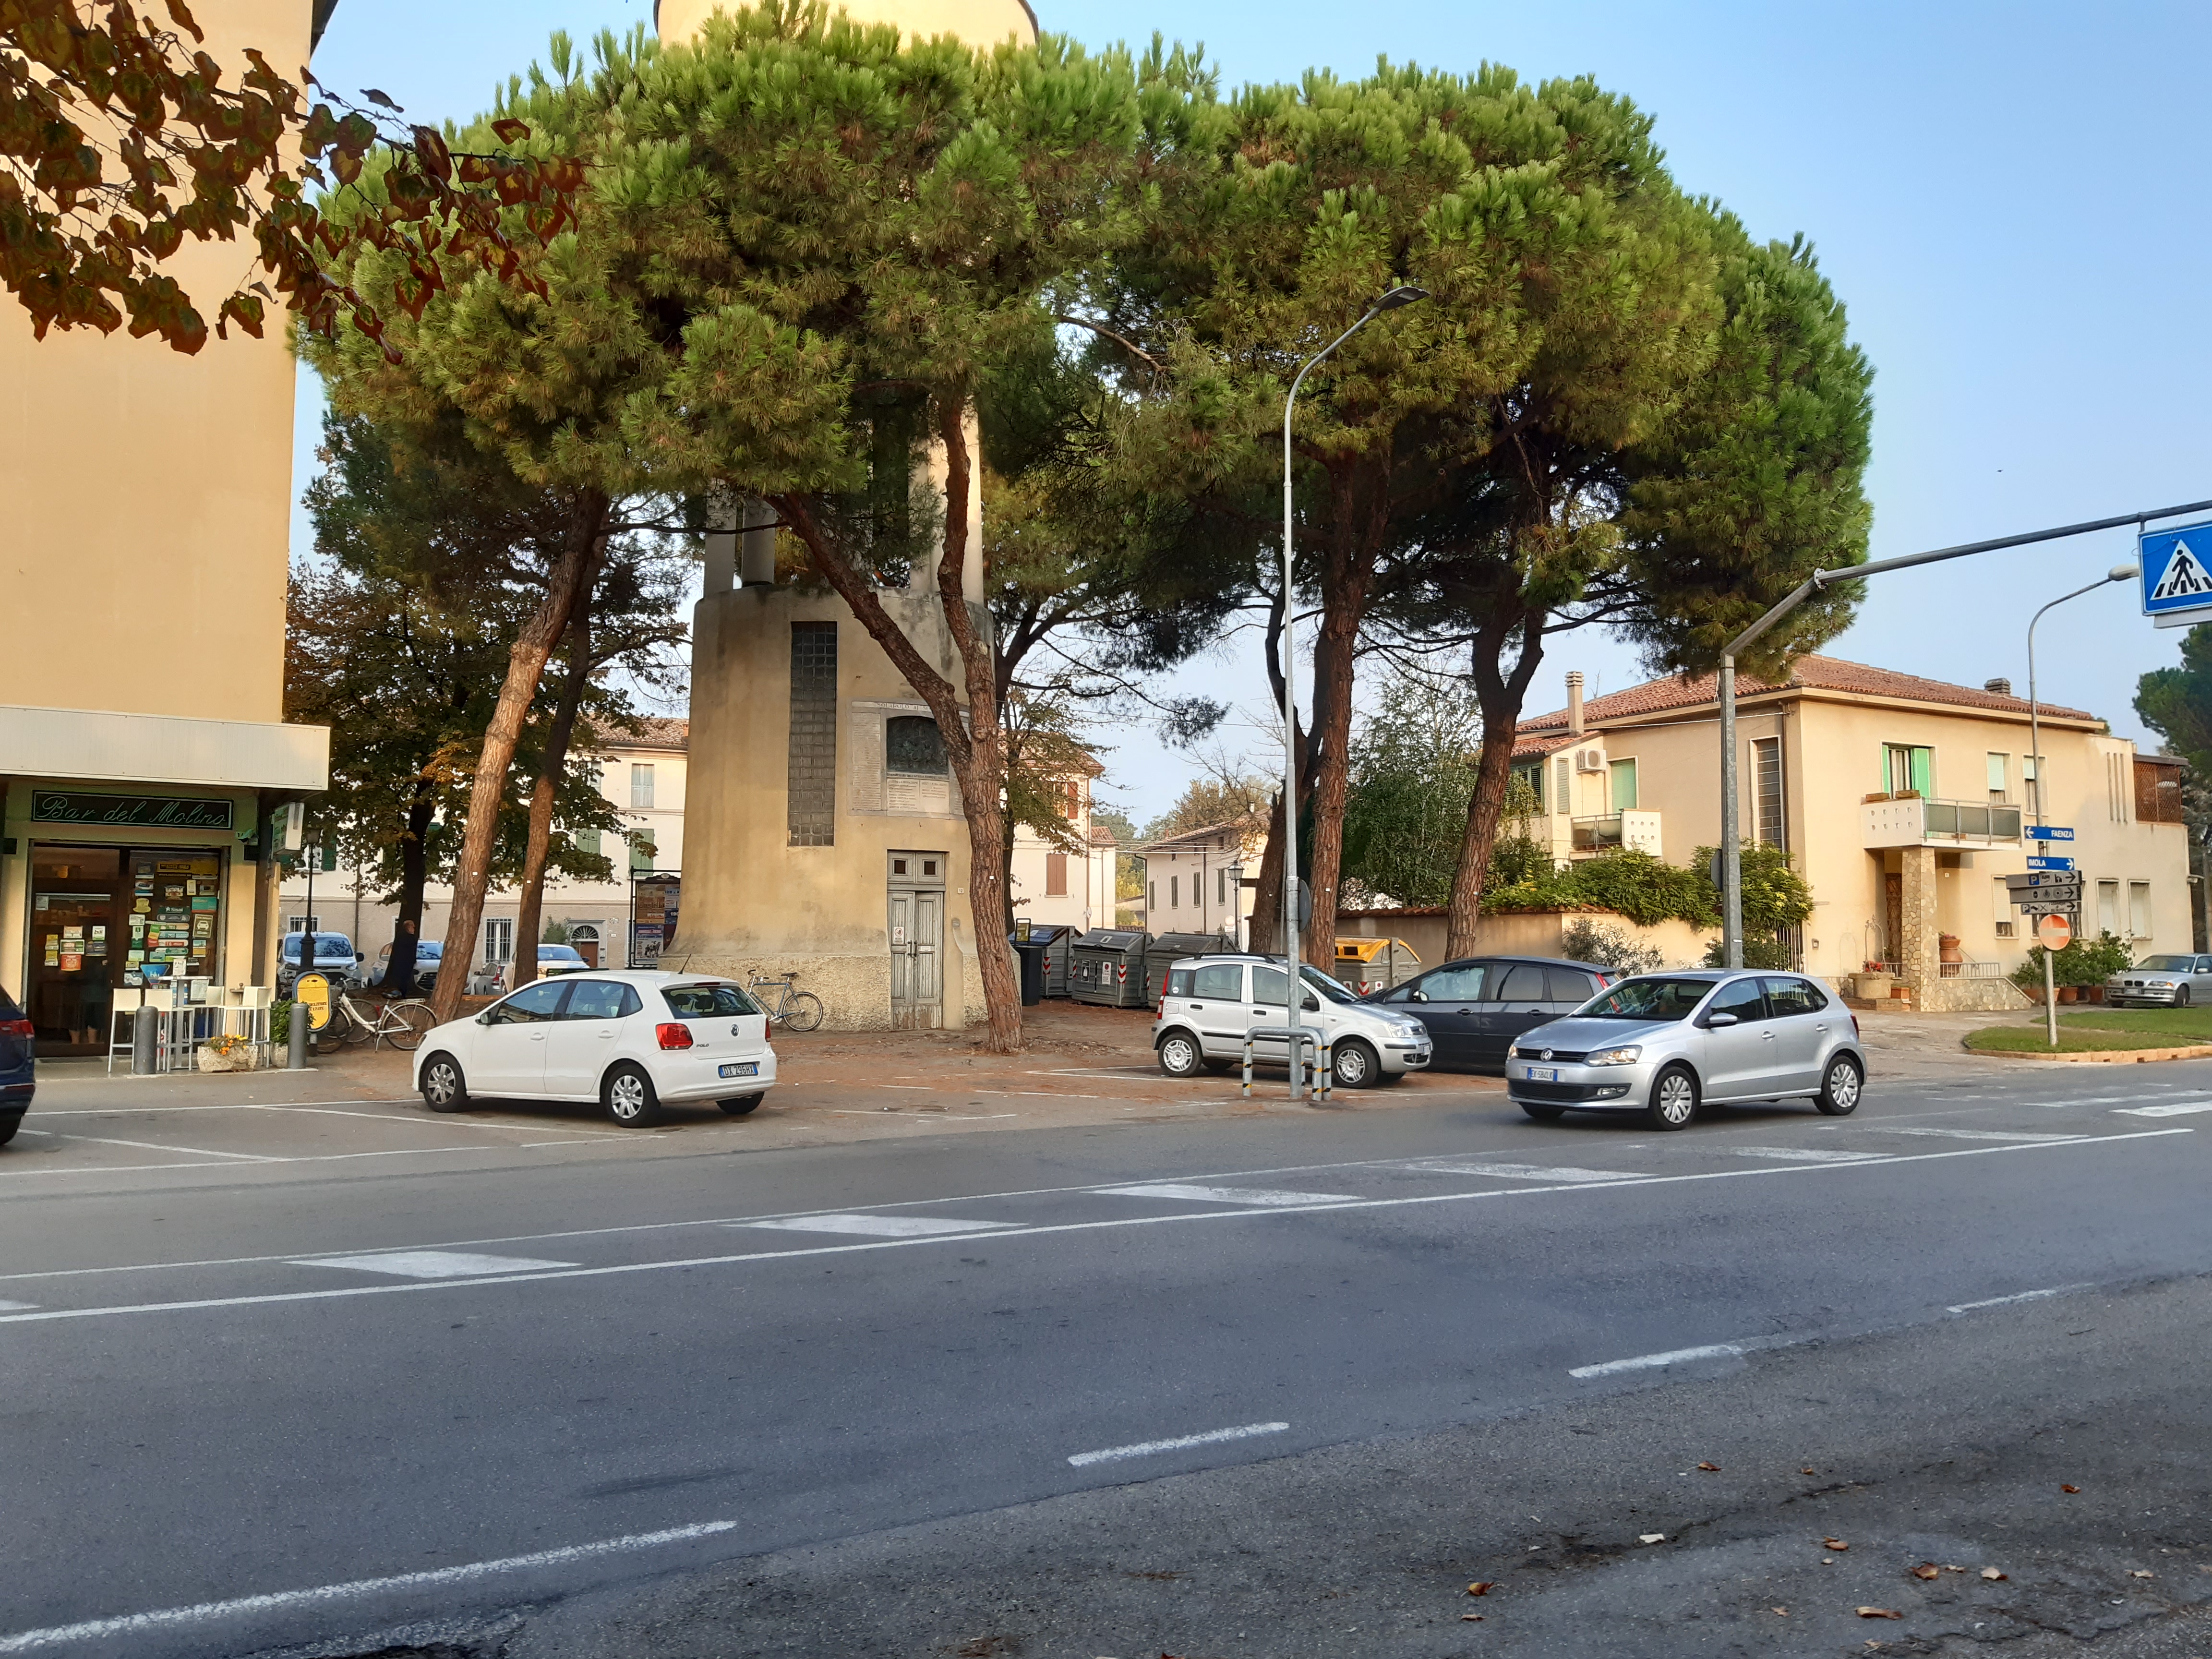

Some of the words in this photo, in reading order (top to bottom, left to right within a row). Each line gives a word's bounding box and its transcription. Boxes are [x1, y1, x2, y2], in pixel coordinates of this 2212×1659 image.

[36, 796, 96, 818] Bar
[103, 801, 147, 822] del
[149, 802, 227, 825] Molino
[2051, 830, 2073, 838] FAENZA
[2028, 859, 2046, 867] IMOLA
[723, 1067, 733, 1076] DX
[734, 1064, 754, 1075] 296HX
